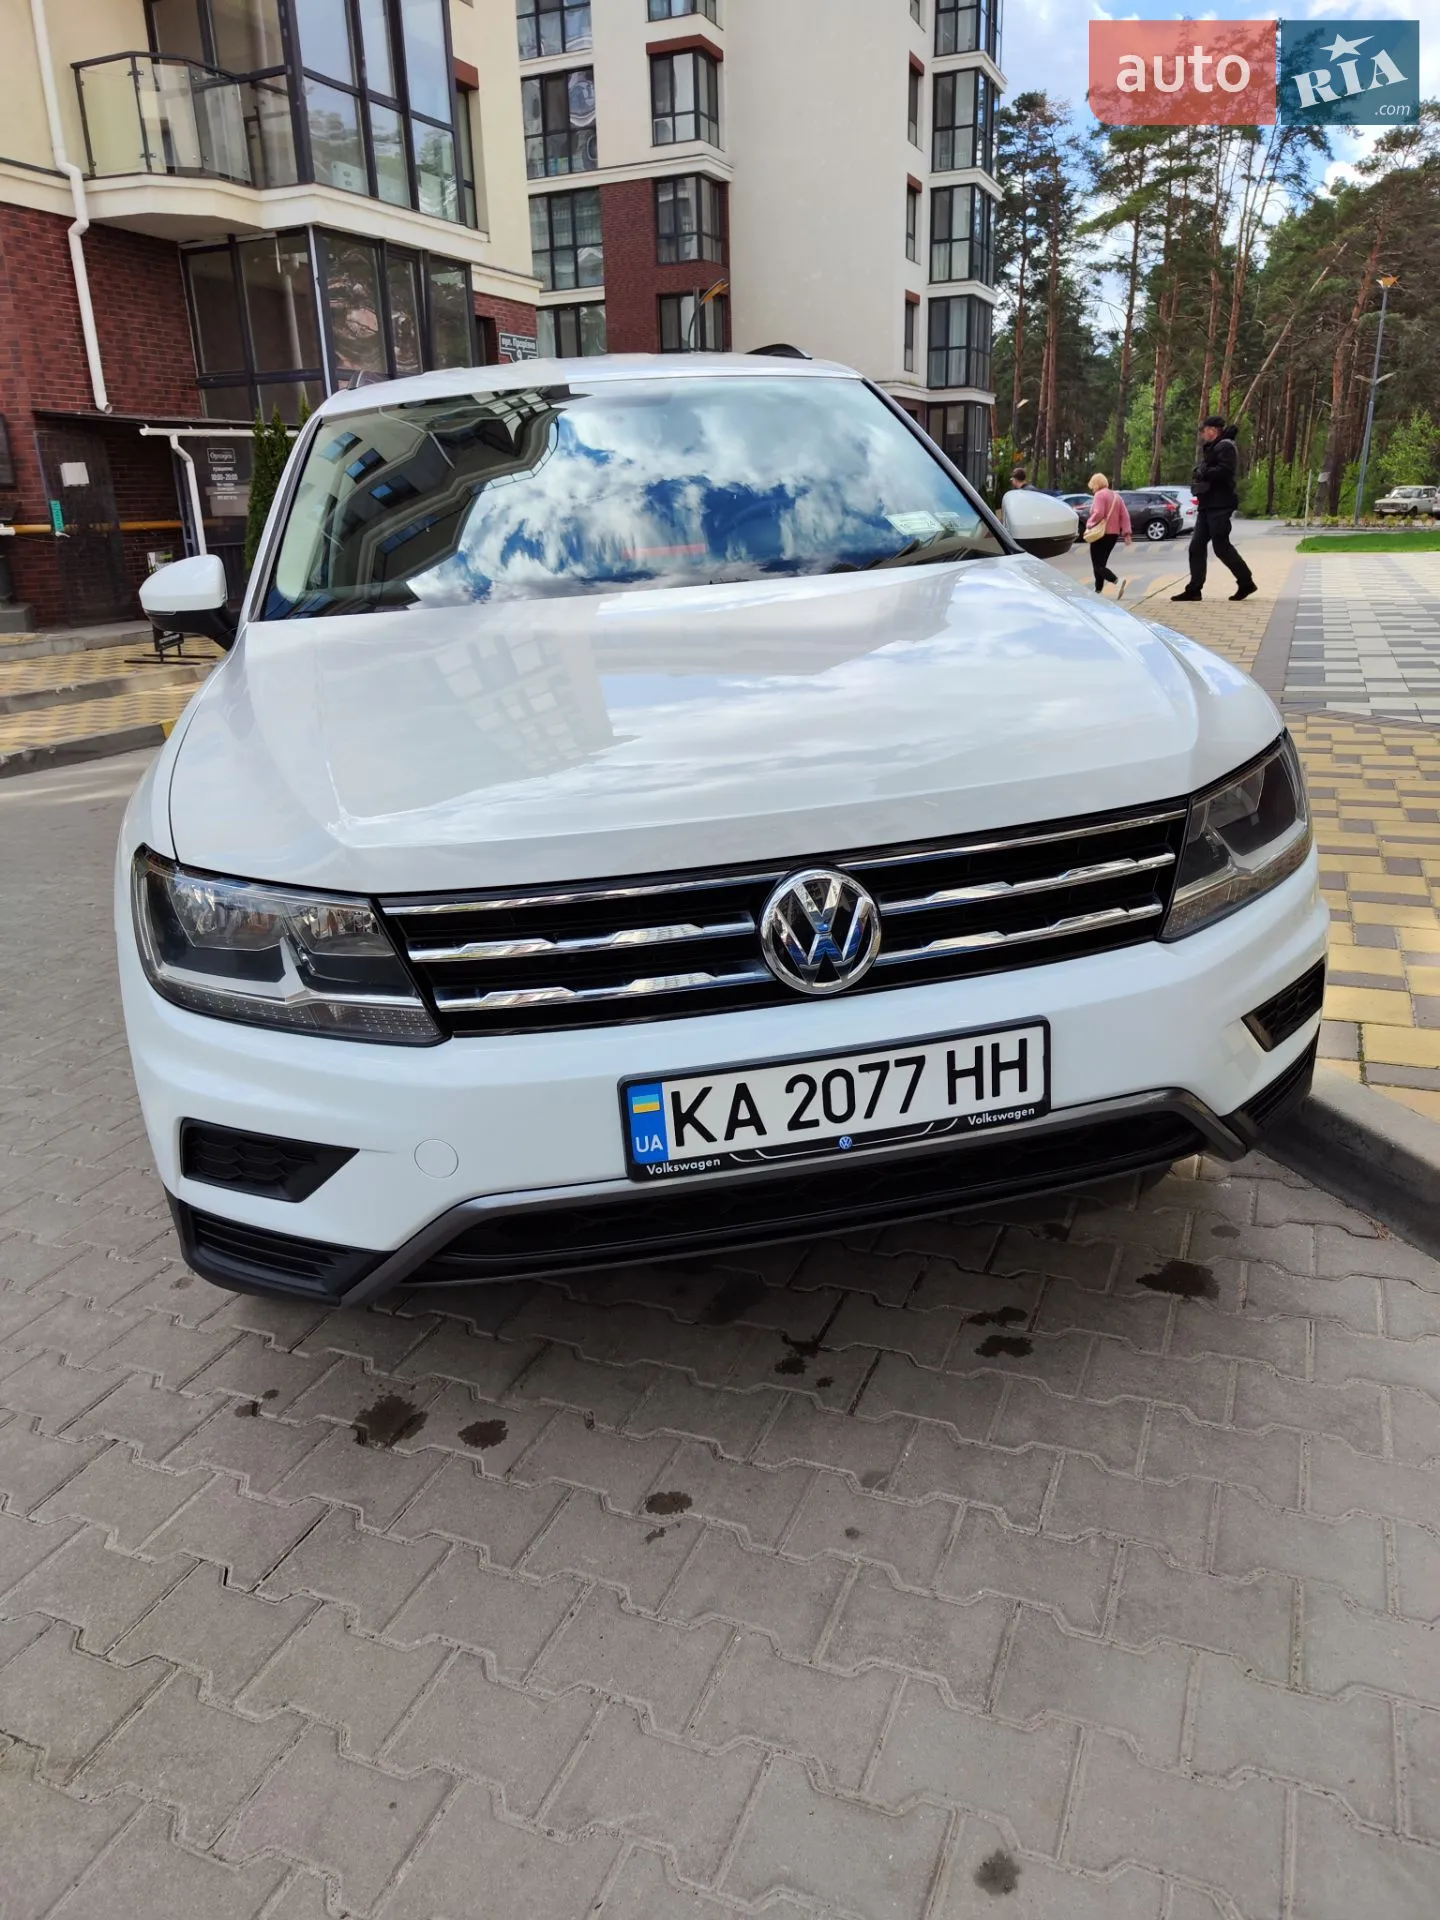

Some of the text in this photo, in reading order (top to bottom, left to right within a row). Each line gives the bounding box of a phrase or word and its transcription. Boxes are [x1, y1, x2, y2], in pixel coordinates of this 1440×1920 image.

[670, 1037, 1028, 1147] KA 2077 HH
[967, 1107, 1035, 1126] Volkswagen
[635, 1134, 663, 1153] UA
[646, 1158, 721, 1175] Volkswagen
